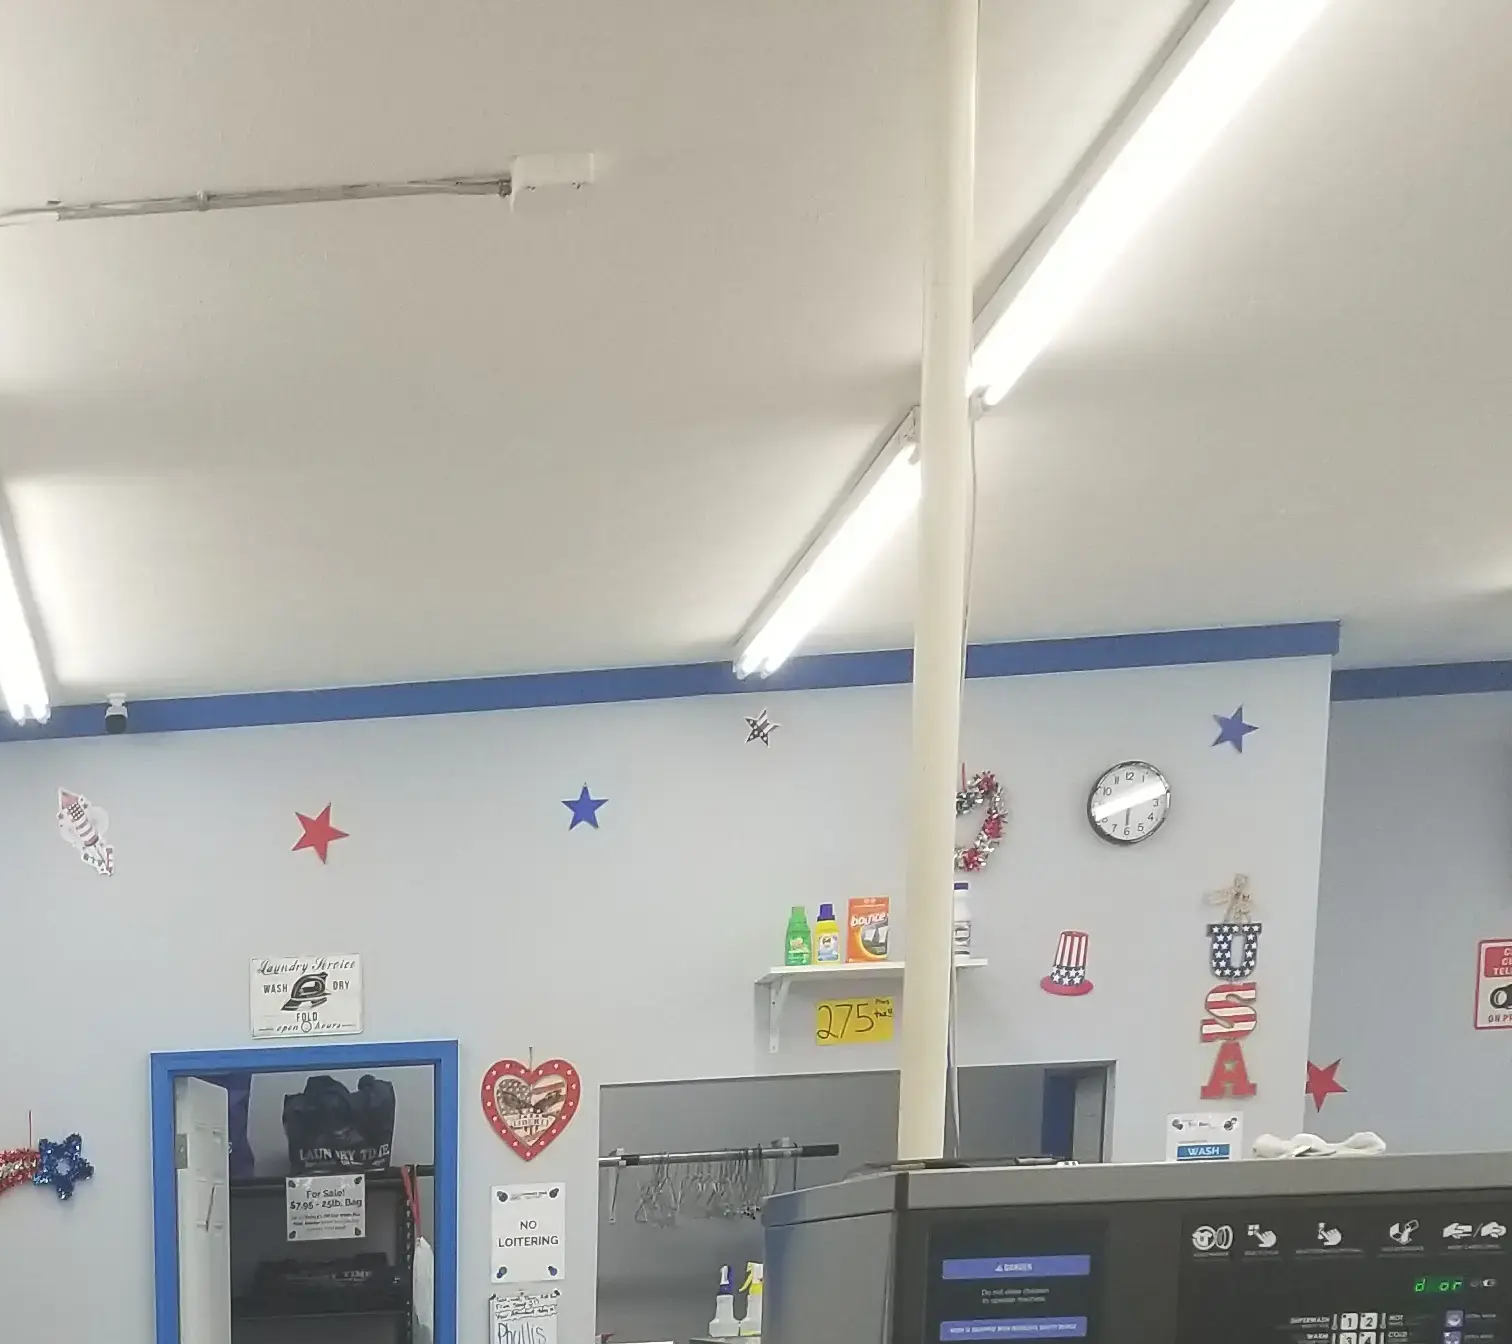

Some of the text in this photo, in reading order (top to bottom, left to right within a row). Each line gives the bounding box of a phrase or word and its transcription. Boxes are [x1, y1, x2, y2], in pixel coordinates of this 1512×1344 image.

[1125, 772, 1134, 781] 12
[1102, 787, 1112, 796] 10
[1112, 824, 1118, 833] 7
[1123, 827, 1130, 836] 6
[1137, 823, 1144, 832] 5
[851, 912, 886, 927] bounce
[258, 960, 308, 975] Laundry
[263, 981, 350, 994] WASH DRY
[296, 1012, 318, 1022] FOLD
[816, 1003, 874, 1039] 275
[1488, 1014, 1500, 1023] ON
[277, 1021, 341, 1033] open hours
[1187, 1146, 1220, 1156] WASH
[306, 1190, 320, 1199] For
[520, 1220, 537, 1230] NO
[498, 1236, 559, 1248] LOITERING
[1346, 1317, 1352, 1328] 1
[1365, 1317, 1373, 1327] 2
